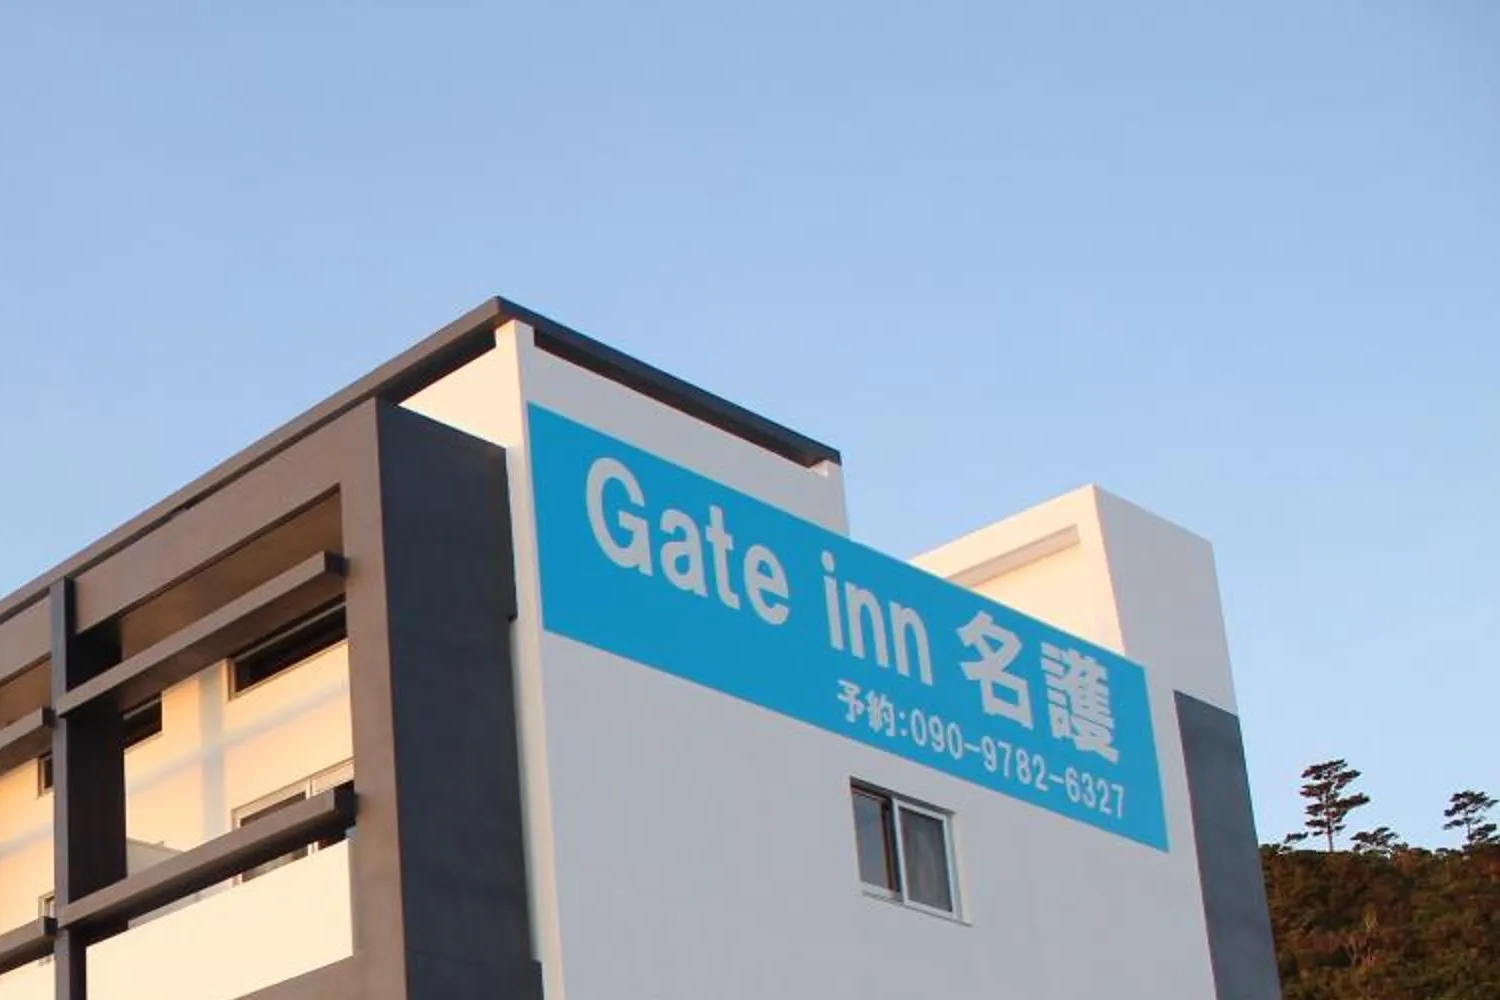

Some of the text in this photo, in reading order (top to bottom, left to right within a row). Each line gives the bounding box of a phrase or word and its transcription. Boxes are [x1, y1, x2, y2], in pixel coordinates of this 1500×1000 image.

[585, 456, 1120, 764] Gate inn 名護
